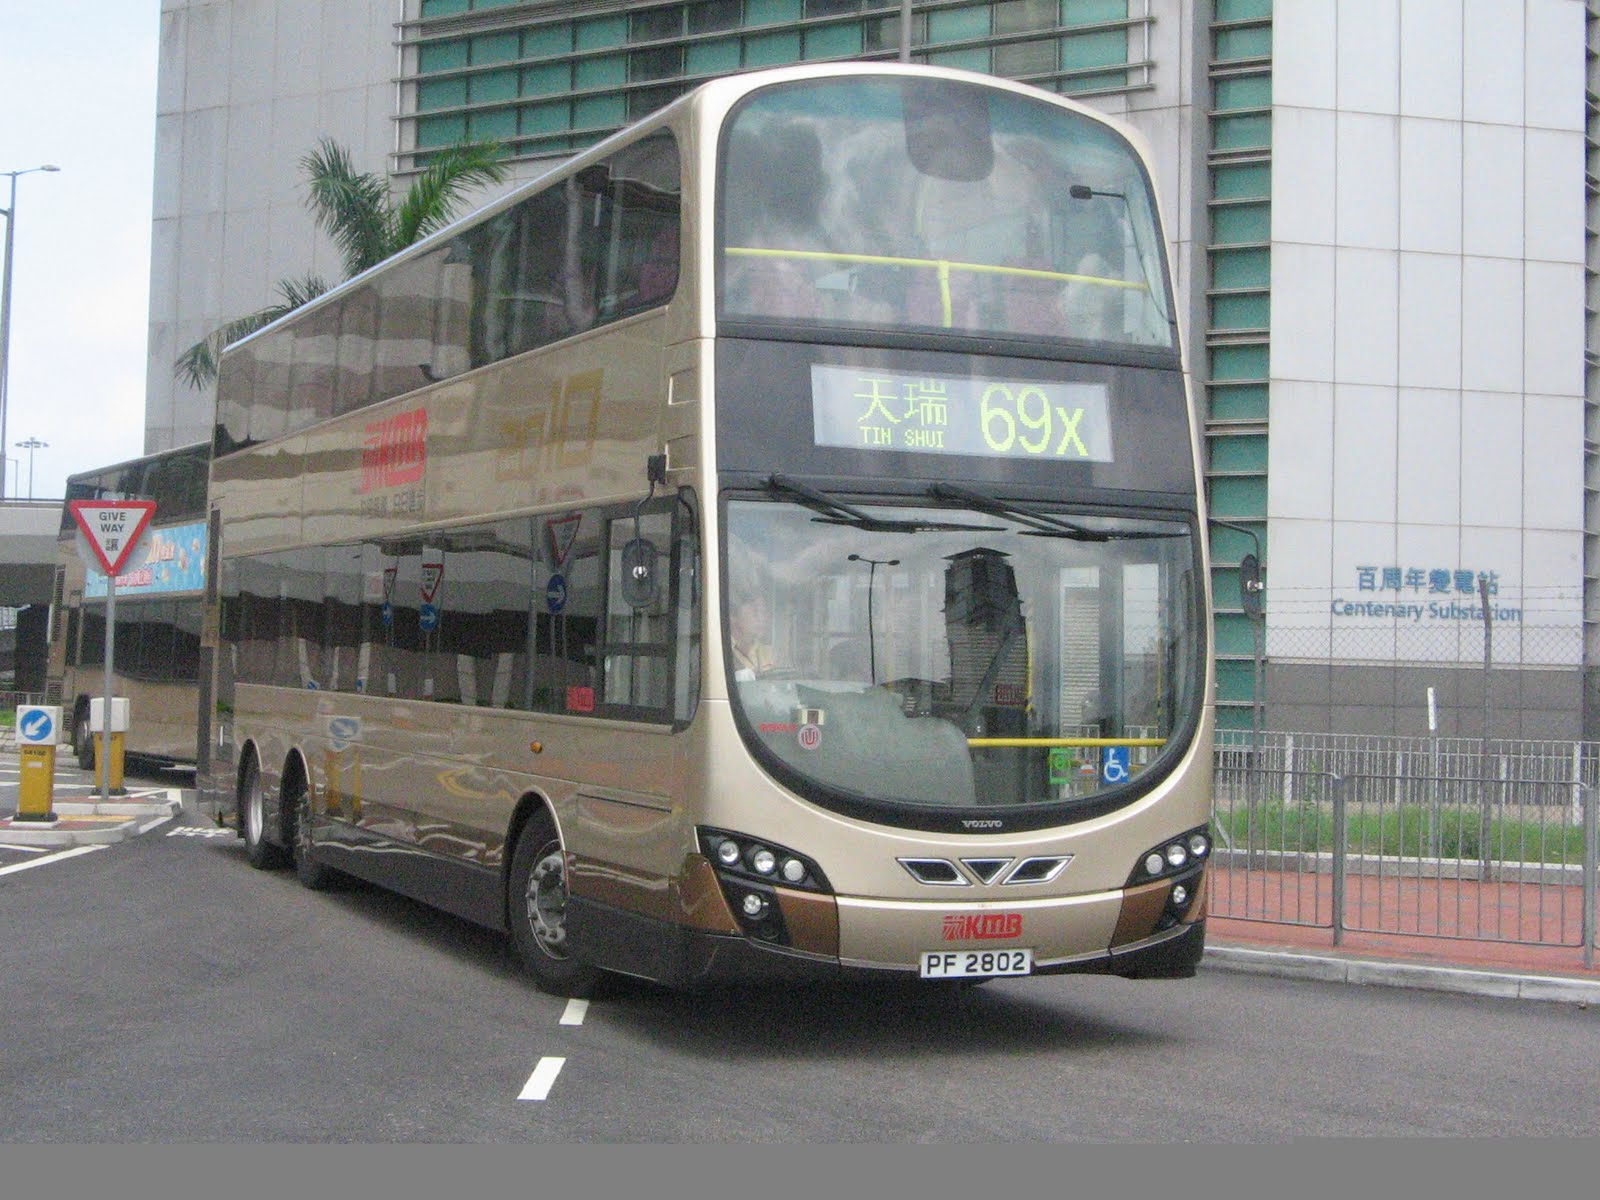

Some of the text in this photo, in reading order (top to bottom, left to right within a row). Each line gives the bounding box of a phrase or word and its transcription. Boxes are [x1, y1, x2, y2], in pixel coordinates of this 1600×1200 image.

[854, 378, 948, 427] 天瑞
[860, 427, 944, 448] TIN SHUI
[99, 511, 126, 521] GIVE
[101, 524, 124, 533] WAY
[1331, 598, 1521, 622] Centenary Substaion
[962, 820, 1002, 828] VOLVO
[965, 914, 1023, 940] KMB
[927, 951, 1025, 975] PF 2802
